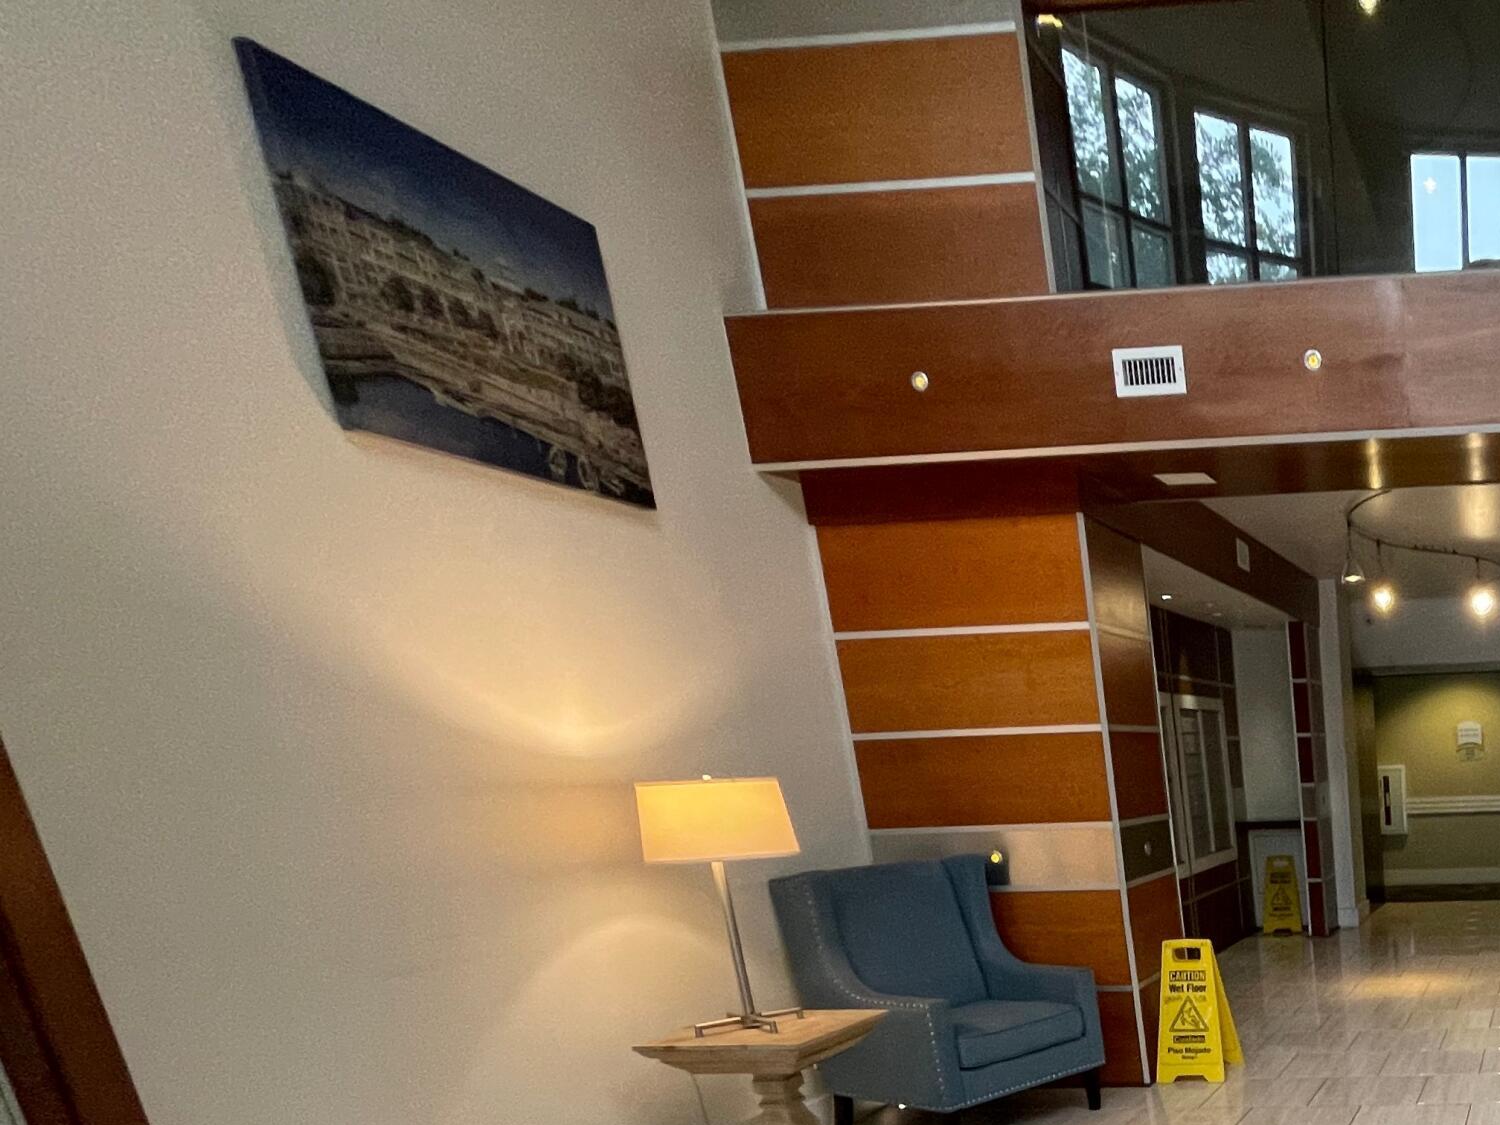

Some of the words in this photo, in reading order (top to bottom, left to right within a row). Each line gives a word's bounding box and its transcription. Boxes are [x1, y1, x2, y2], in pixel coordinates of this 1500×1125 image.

[1169, 971, 1206, 981] CAUTION
[1169, 983, 1184, 993] Wet
[1187, 983, 1207, 993] Floor
